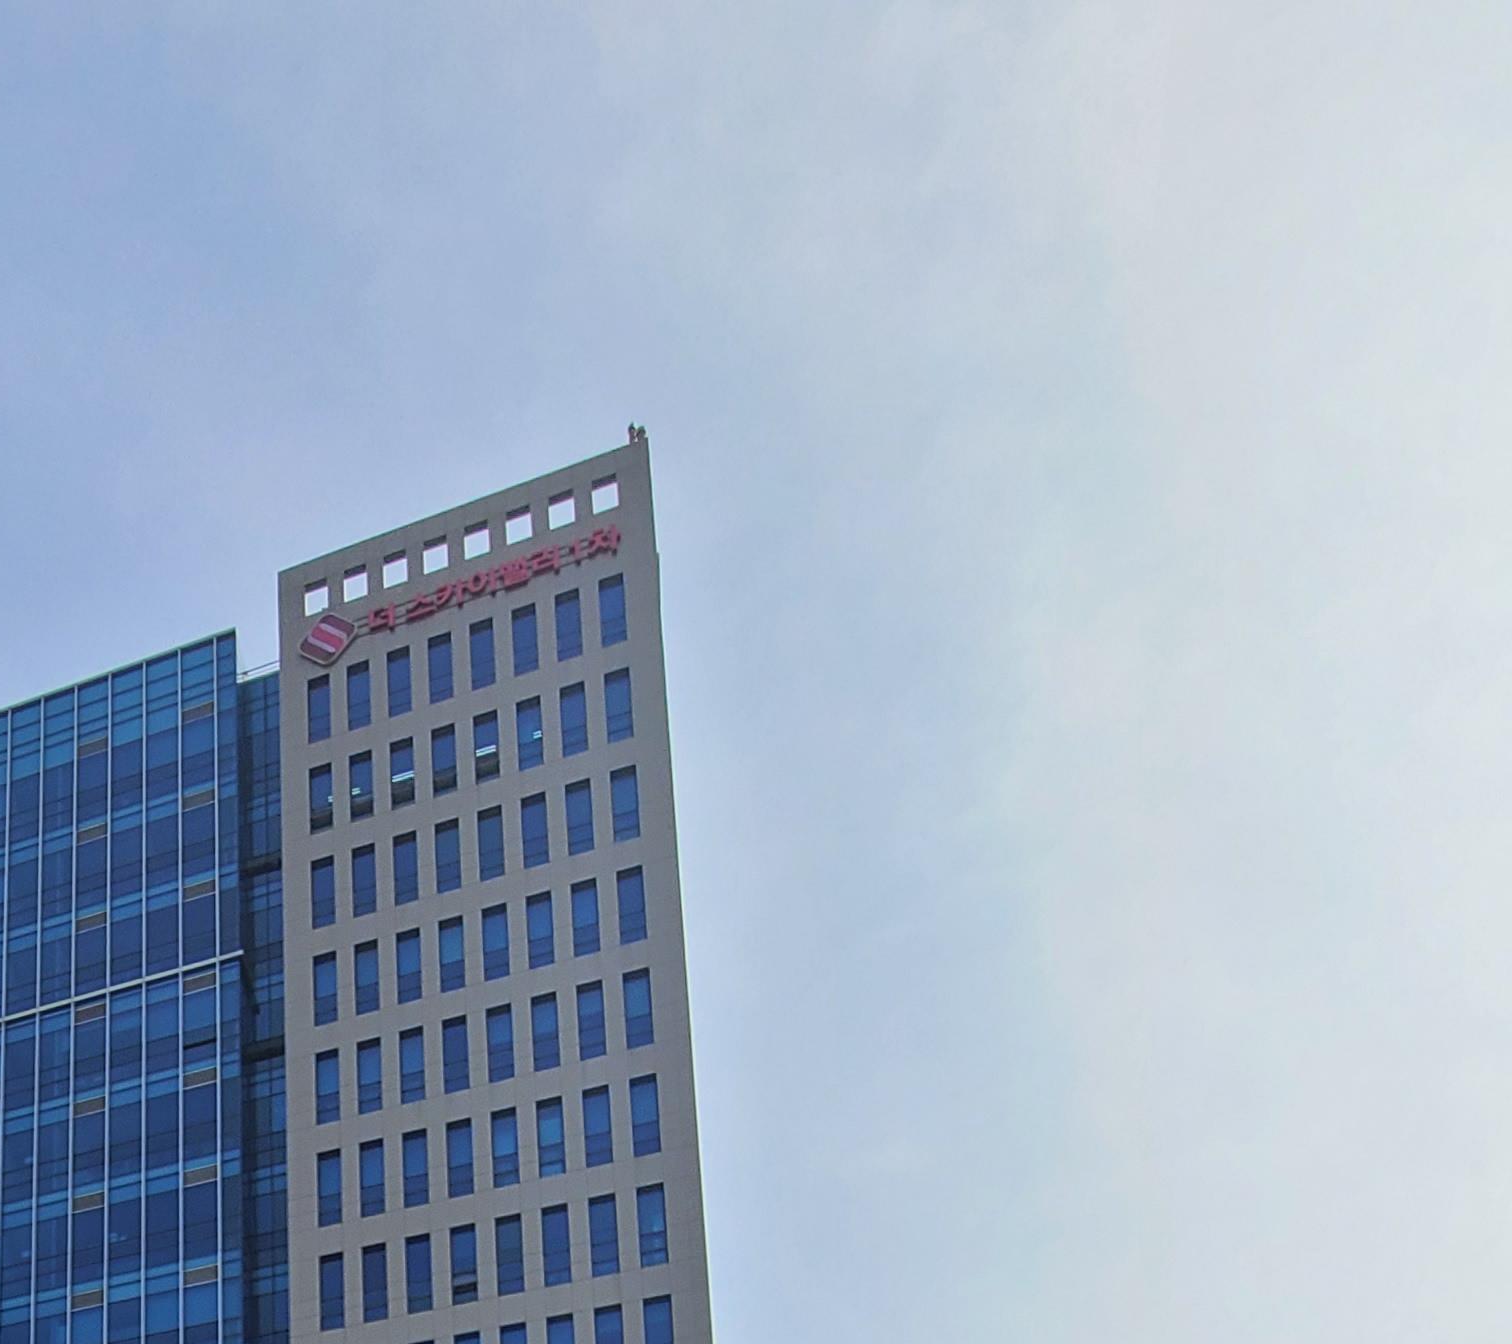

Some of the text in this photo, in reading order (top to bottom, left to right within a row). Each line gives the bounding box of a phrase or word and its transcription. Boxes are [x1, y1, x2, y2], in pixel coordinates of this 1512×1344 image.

[366, 523, 622, 633] 더 스카이밸리 1차
